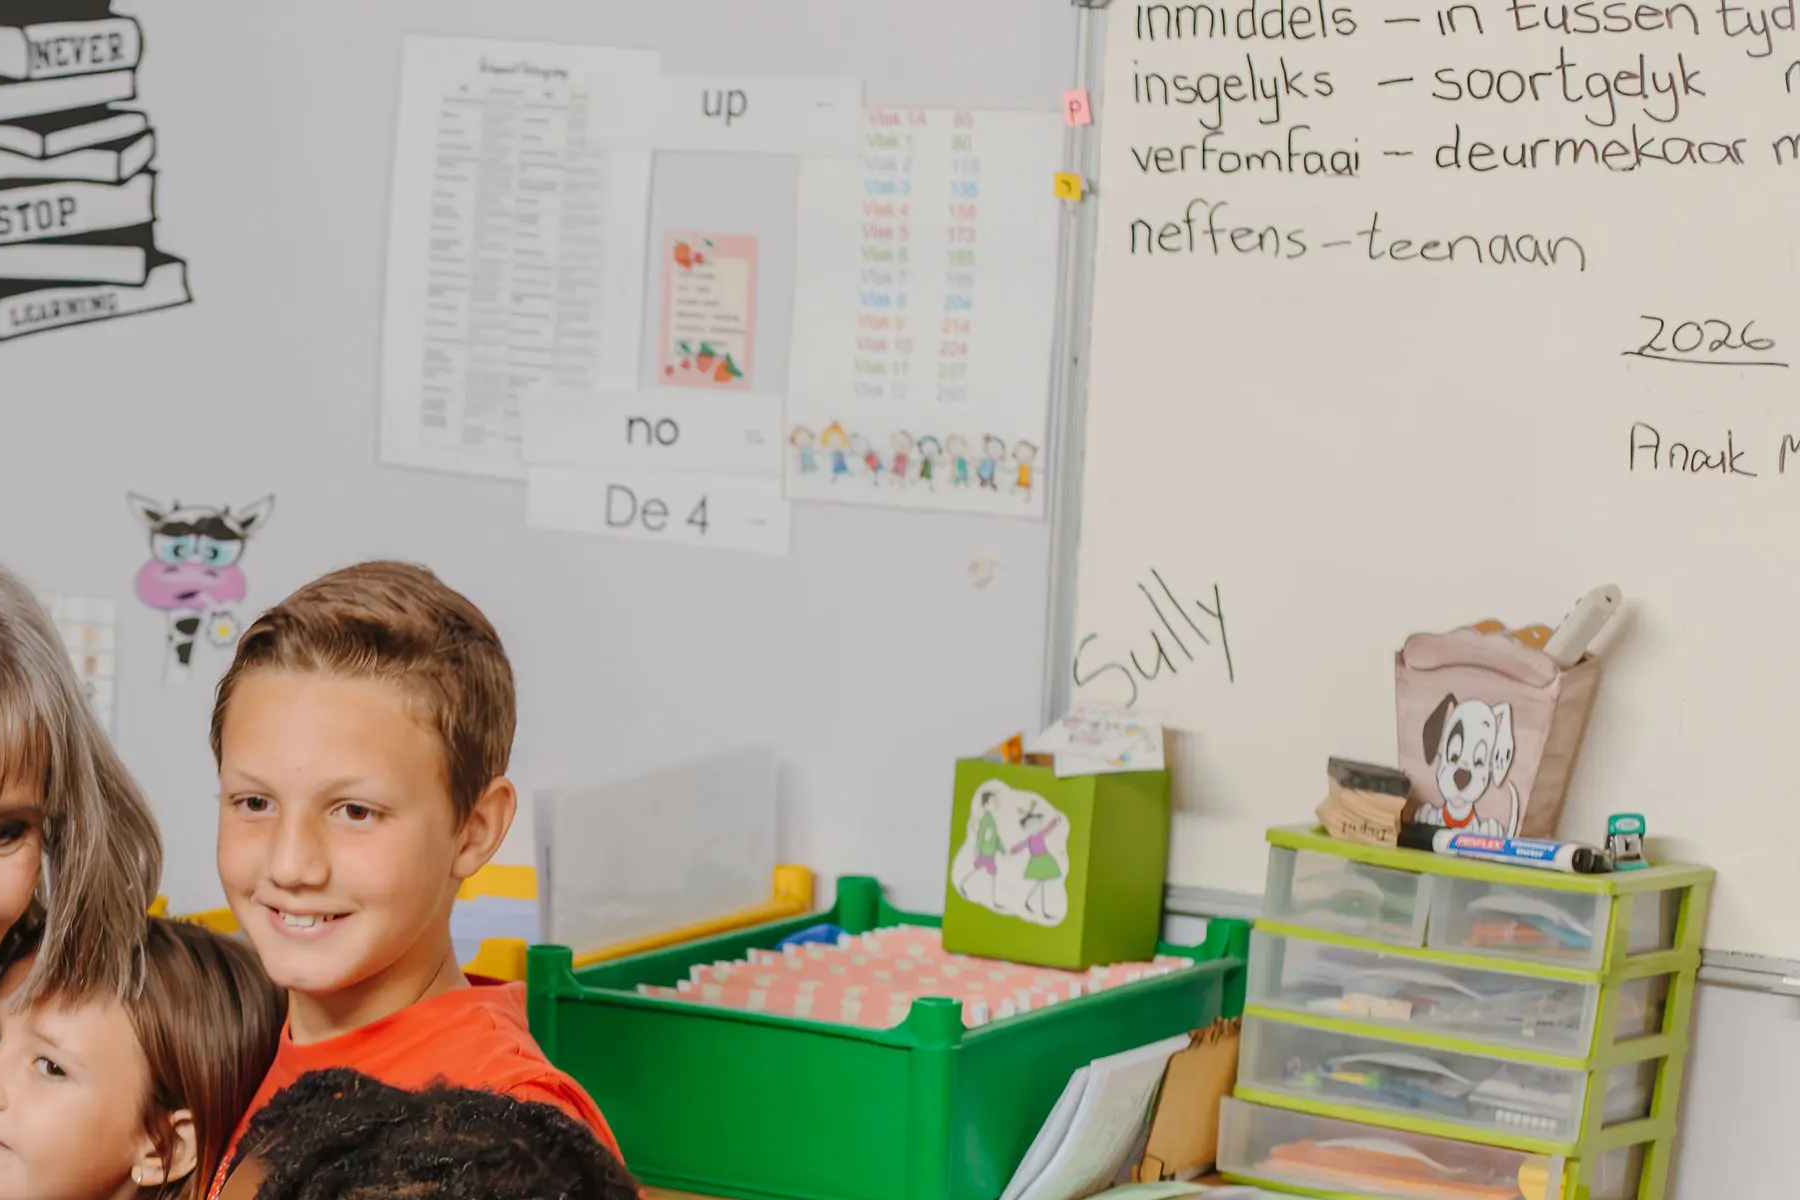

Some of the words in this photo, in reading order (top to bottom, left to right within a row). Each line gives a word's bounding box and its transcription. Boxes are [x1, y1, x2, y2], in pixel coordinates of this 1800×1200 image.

[32, 32, 125, 70] NEVER
[1137, 0, 1358, 40] inmiddels
[1437, 4, 1483, 36] in
[1506, 0, 1699, 35] tussen
[1715, 0, 1795, 58] tyd
[701, 88, 748, 129] up
[1132, 53, 1334, 130] insgelyks
[1432, 45, 1706, 127] soortgelyk
[1130, 126, 1360, 175] verfomfaai
[1436, 123, 1746, 171] deurmekaar
[1129, 198, 1307, 259] neffens
[1357, 211, 1586, 272] teenaan
[9, 293, 118, 327] LEARNING
[1640, 314, 1777, 356] 2026
[626, 415, 680, 446] no
[604, 483, 671, 533] De
[685, 492, 709, 537] 4
[1073, 567, 1235, 710] Sully
